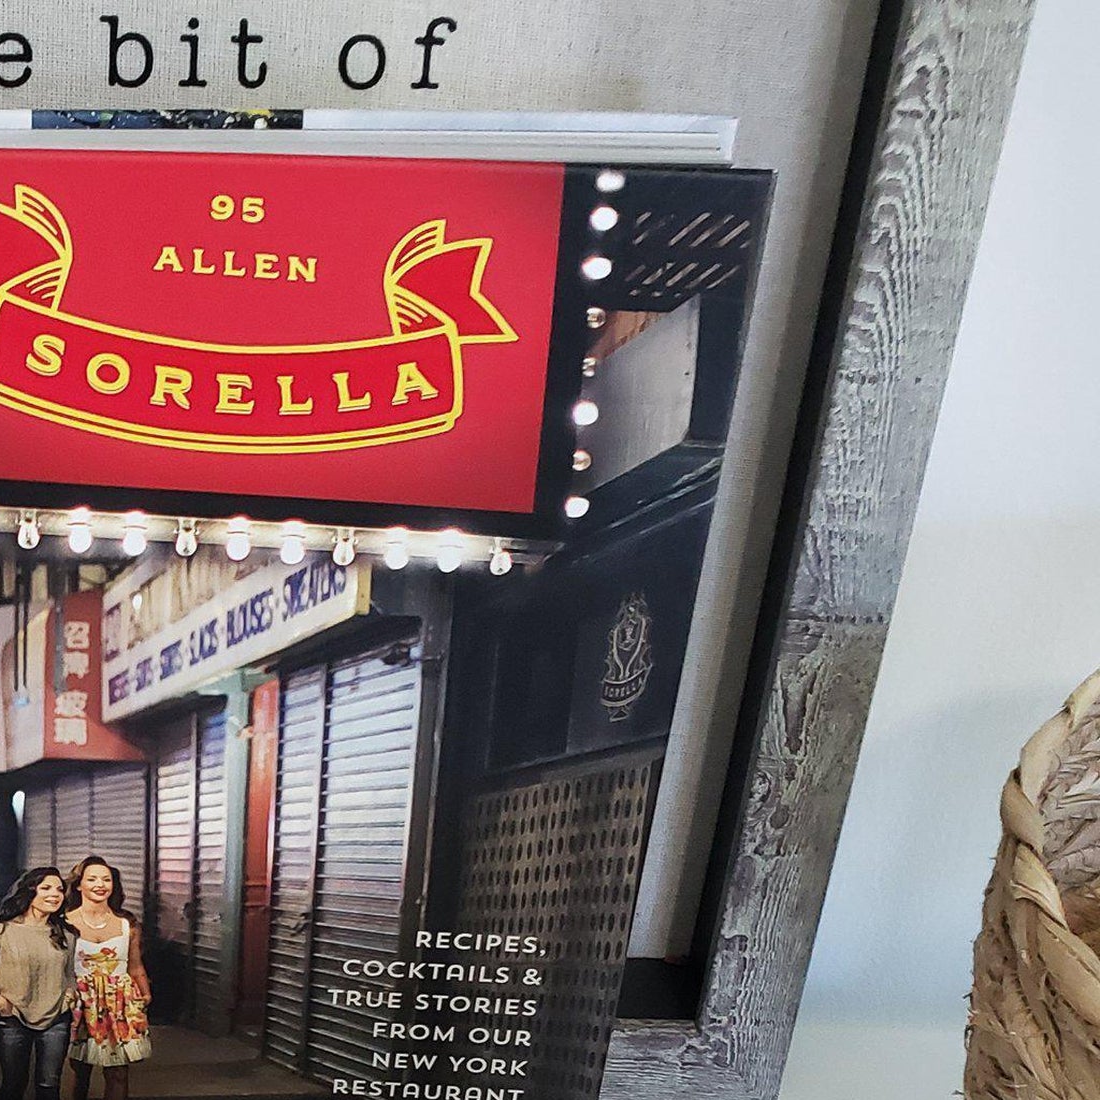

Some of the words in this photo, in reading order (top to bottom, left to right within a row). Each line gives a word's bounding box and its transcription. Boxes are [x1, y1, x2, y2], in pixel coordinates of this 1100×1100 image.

[106, 15, 268, 90] bit
[337, 17, 458, 91] of
[210, 194, 265, 223] 95
[153, 246, 317, 283] ALLEN
[26, 333, 439, 417] SORELLA
[415, 930, 547, 956] RECIPES,
[342, 959, 510, 984] COCKTAILS
[522, 968, 542, 987] &
[327, 988, 403, 1010] TRUE
[414, 994, 538, 1017] STORIES
[372, 1022, 455, 1042] FROM
[468, 1027, 532, 1047] OUR
[371, 1052, 438, 1071] NEW
[449, 1056, 529, 1077] YORK
